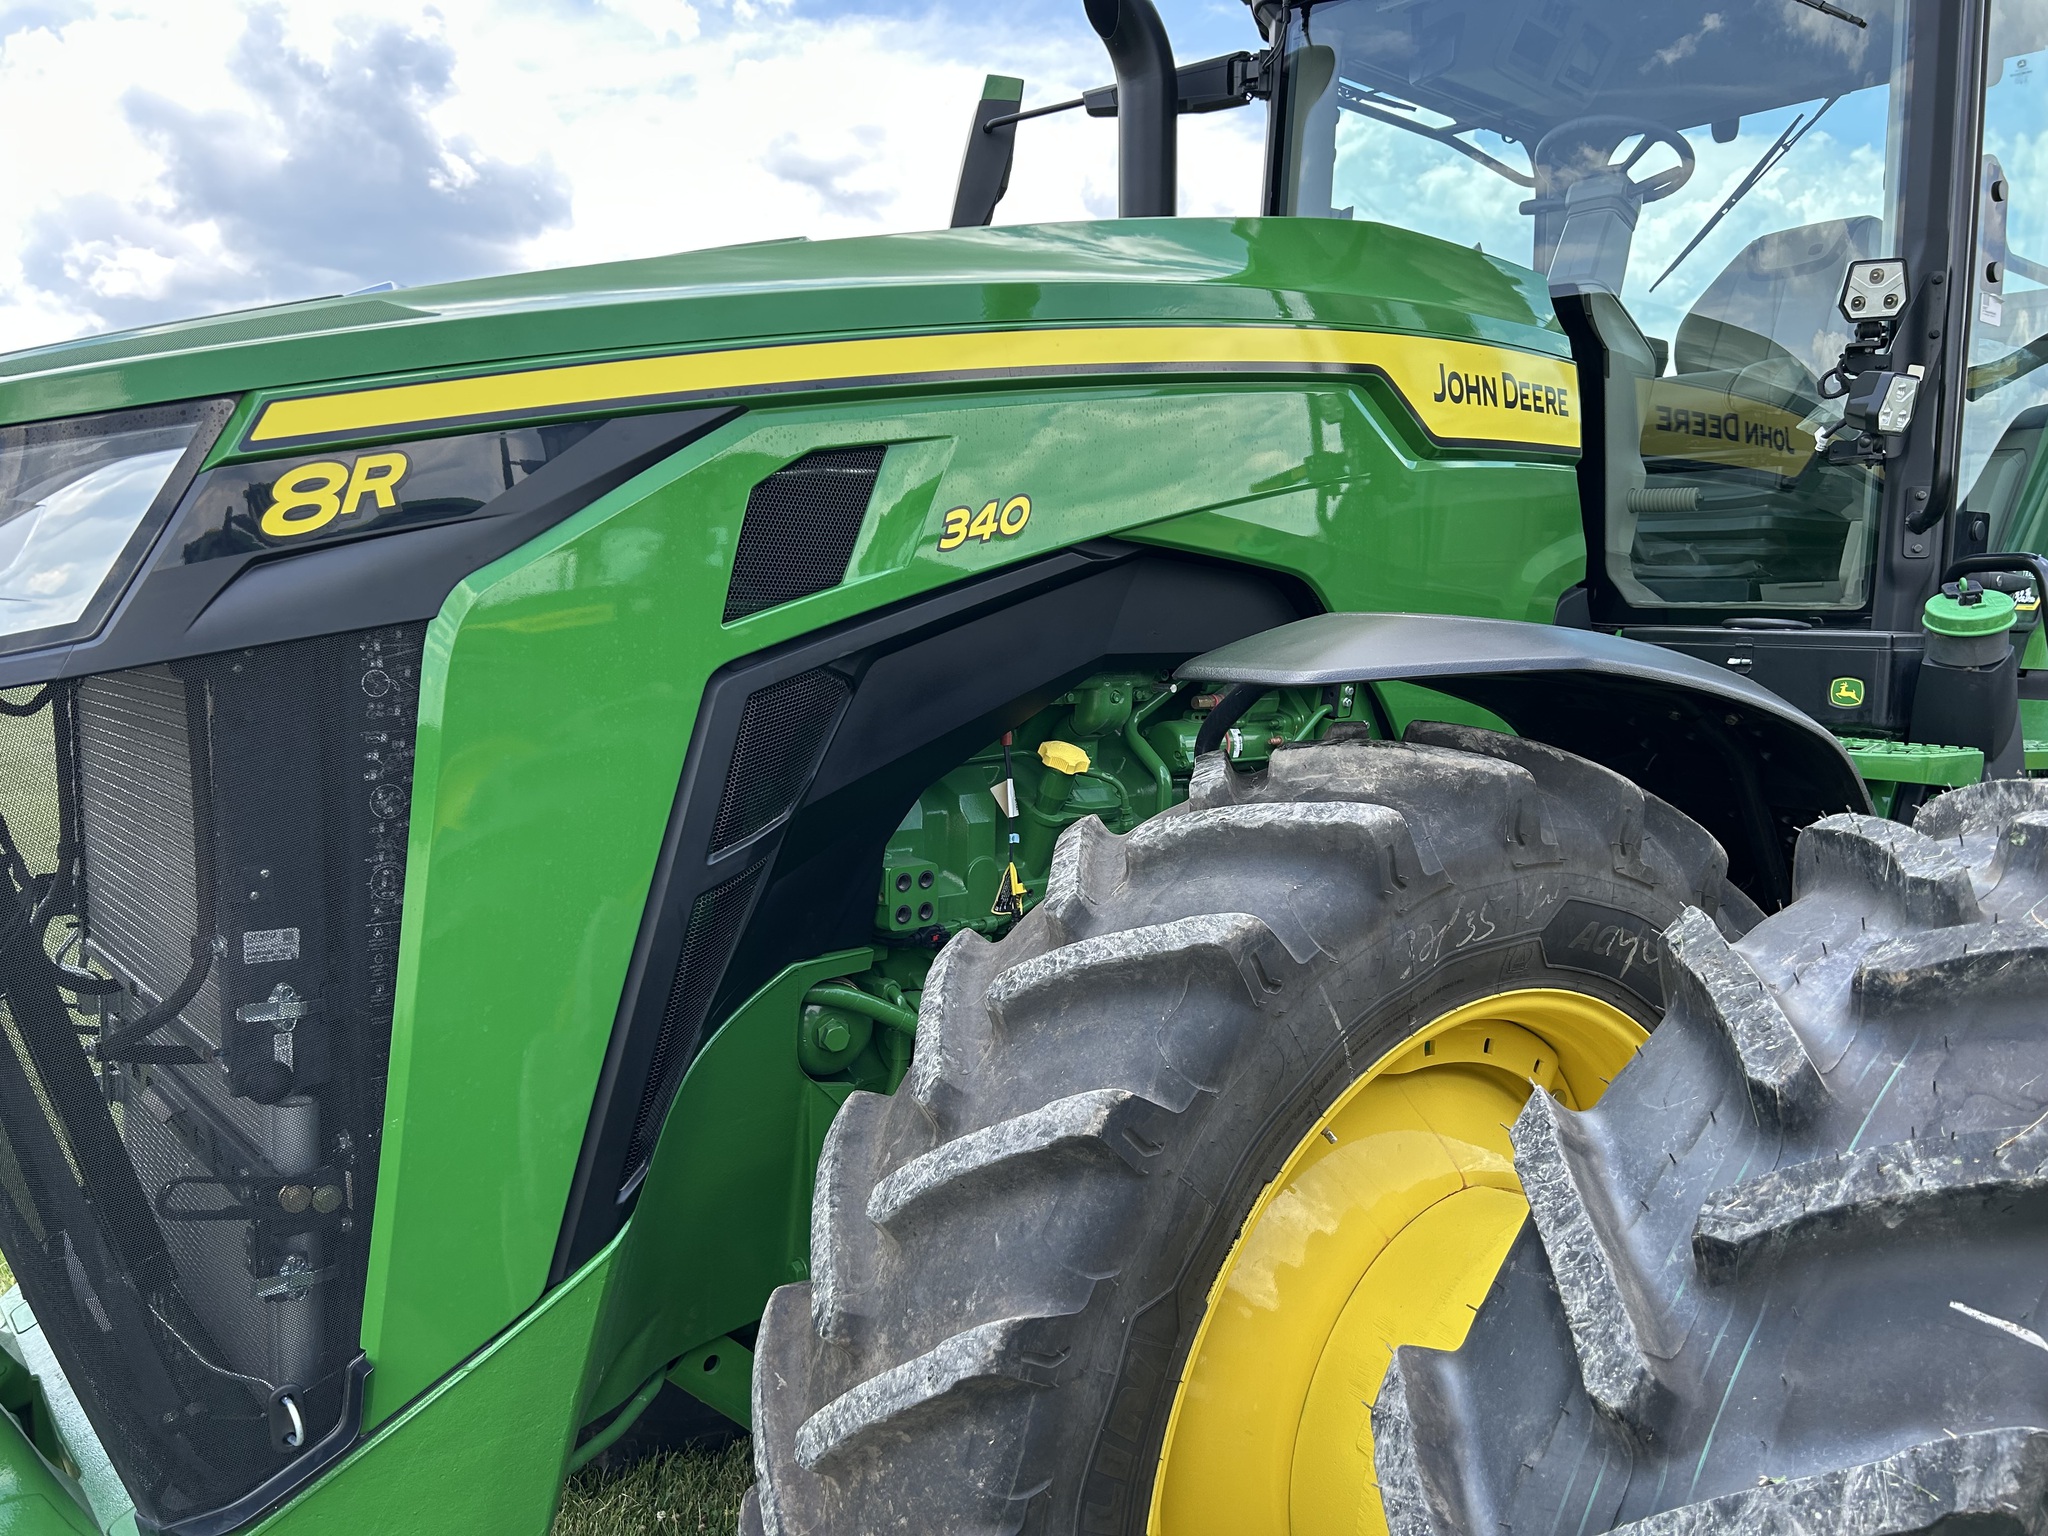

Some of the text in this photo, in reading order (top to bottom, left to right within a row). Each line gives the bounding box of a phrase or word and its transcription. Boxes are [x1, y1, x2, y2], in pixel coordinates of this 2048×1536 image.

[1433, 363, 1570, 418] JOHN DEERE
[261, 452, 408, 537] 8R
[938, 495, 1031, 550] 340
